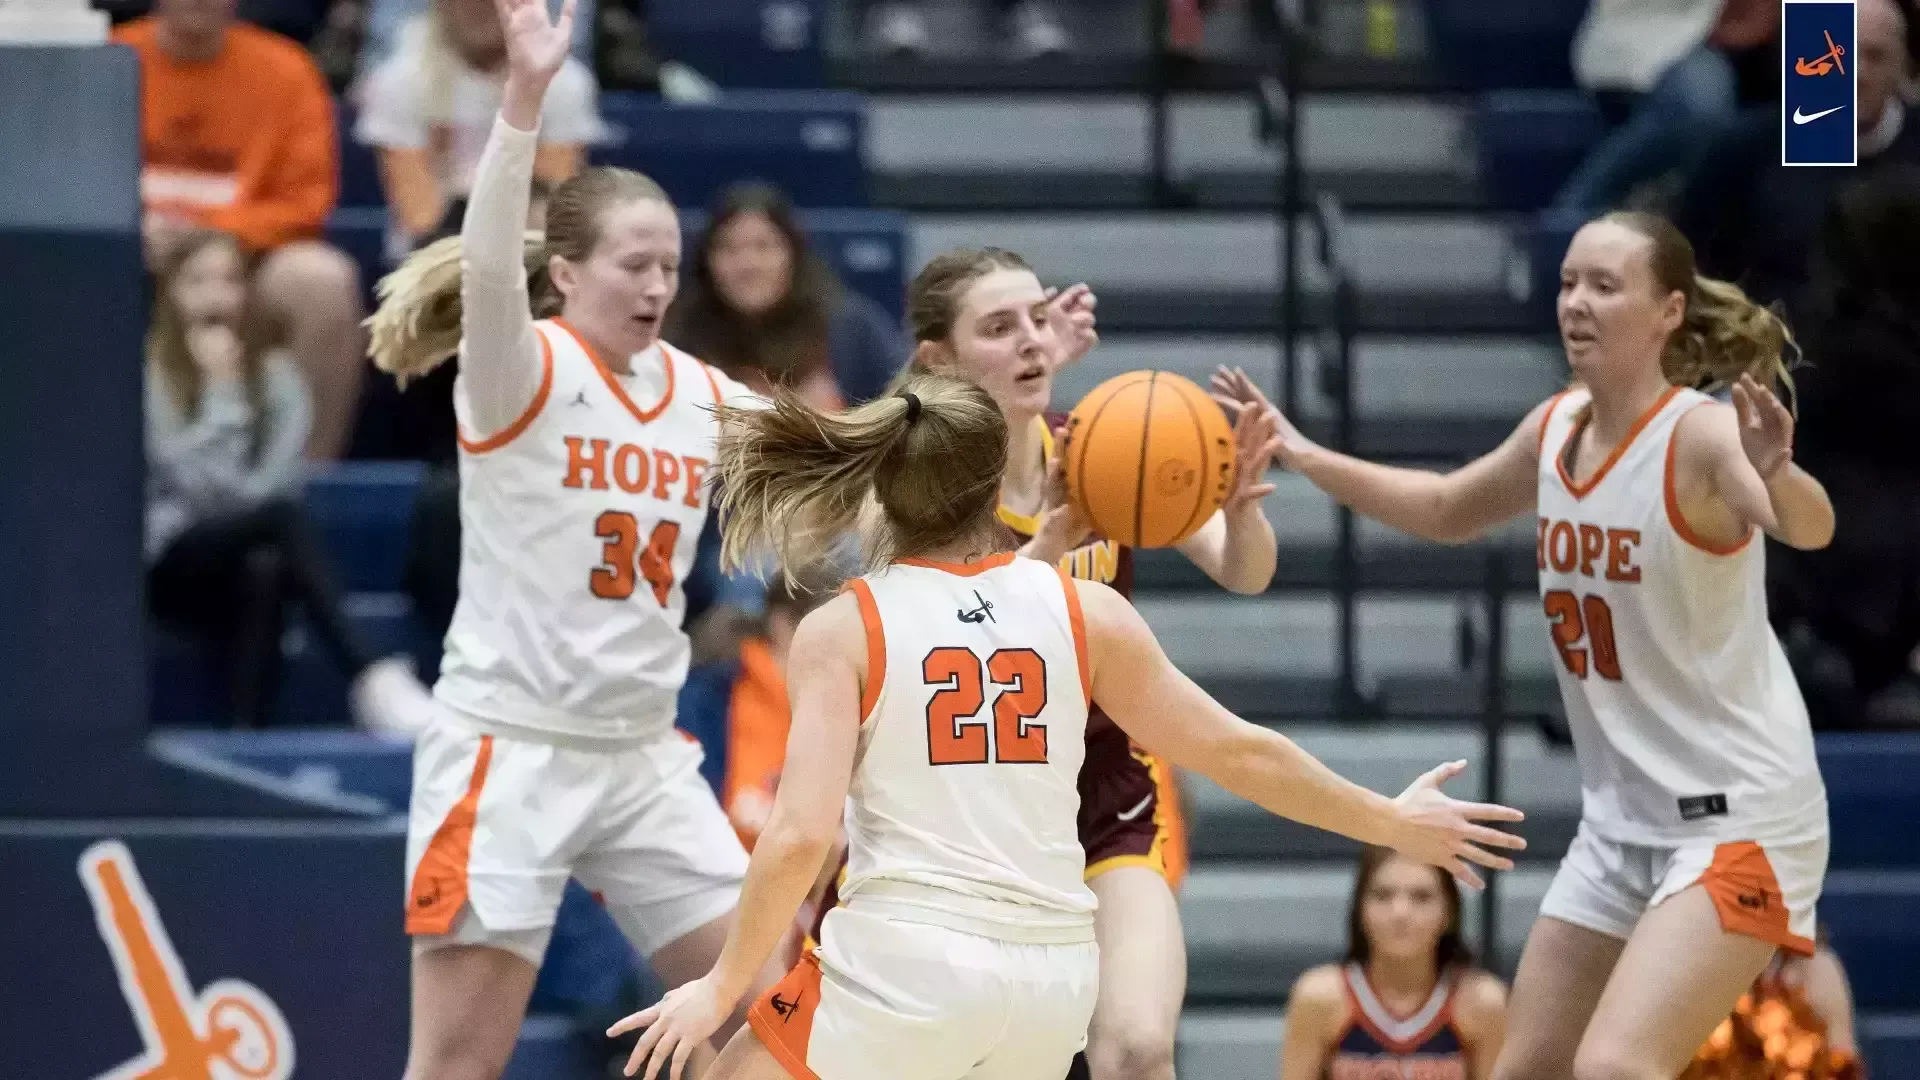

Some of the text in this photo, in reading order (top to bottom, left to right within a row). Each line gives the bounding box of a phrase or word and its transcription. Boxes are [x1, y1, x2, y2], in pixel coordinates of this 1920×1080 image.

[563, 435, 709, 508] HOPE
[590, 509, 681, 609] 34
[1544, 588, 1622, 681] 20
[921, 646, 1049, 766] 22
